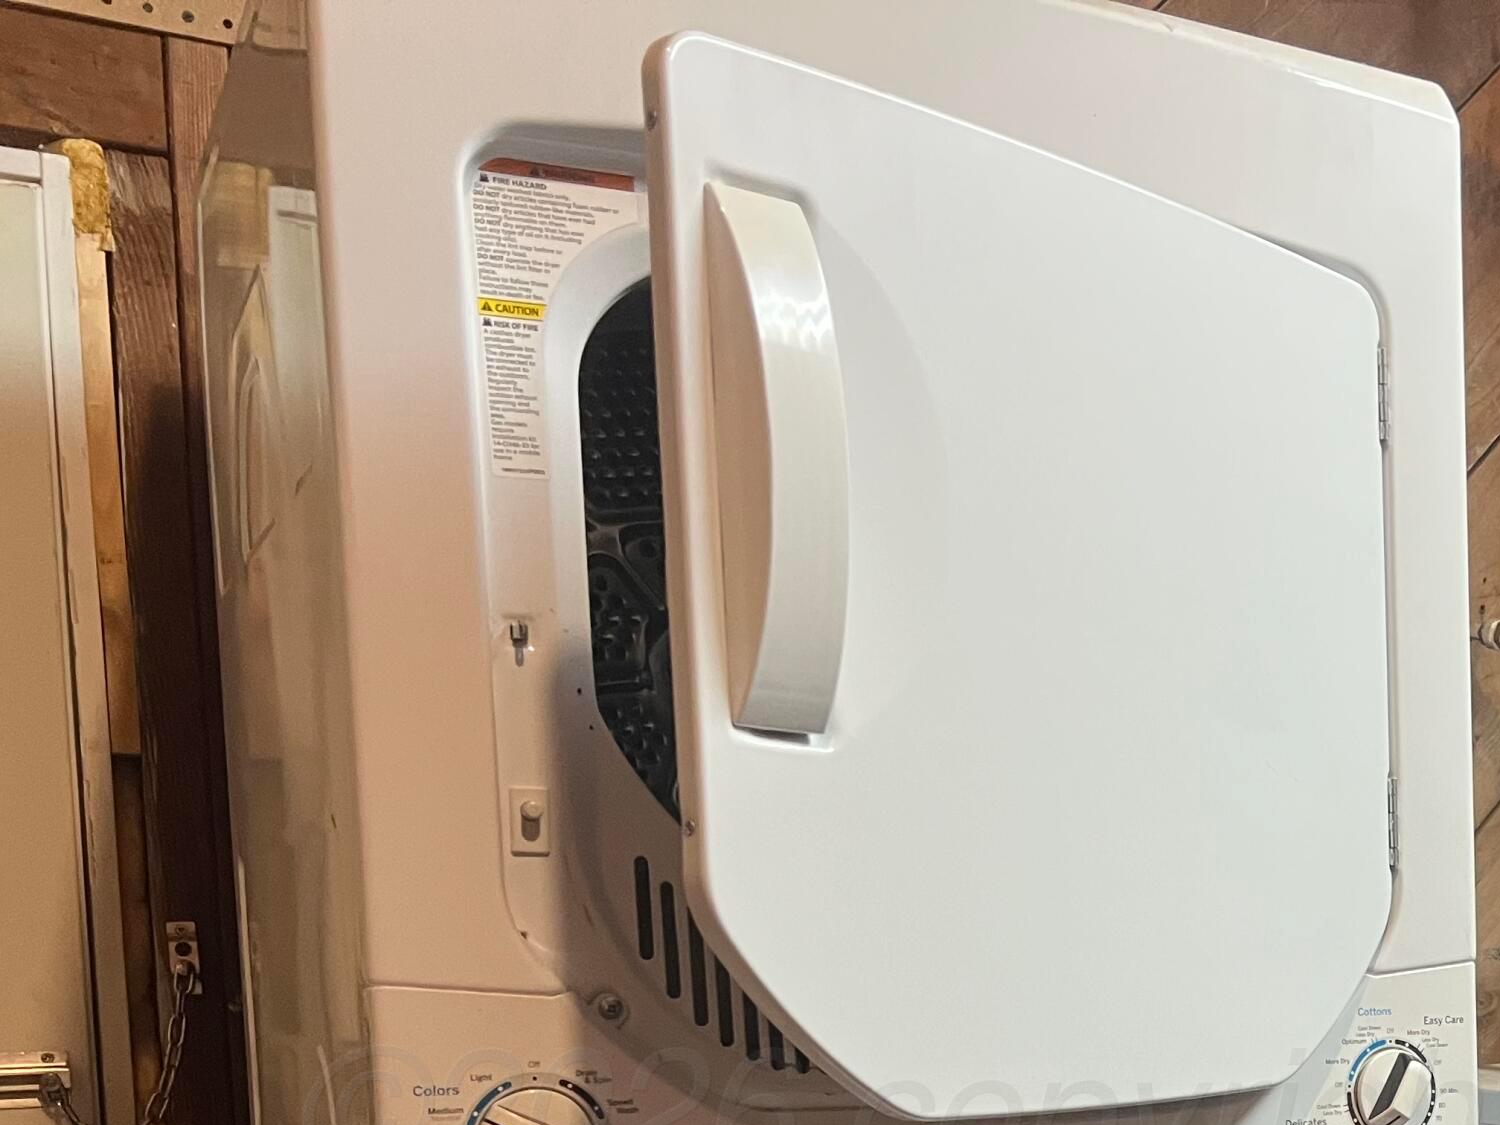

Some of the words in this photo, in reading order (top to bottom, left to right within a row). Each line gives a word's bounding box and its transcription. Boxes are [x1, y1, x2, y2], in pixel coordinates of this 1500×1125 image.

[492, 176, 510, 186] FIRE
[512, 178, 547, 190] HAZARD
[495, 303, 539, 317] CAUTION
[494, 320, 510, 329] RISK
[512, 321, 521, 330] OF
[1357, 1007, 1392, 1016] Cottons
[1423, 1016, 1442, 1025] Easy
[1445, 1016, 1464, 1024] Care
[470, 1073, 492, 1083] Light
[412, 1084, 460, 1097] Colors
[427, 1106, 464, 1115] Medium
